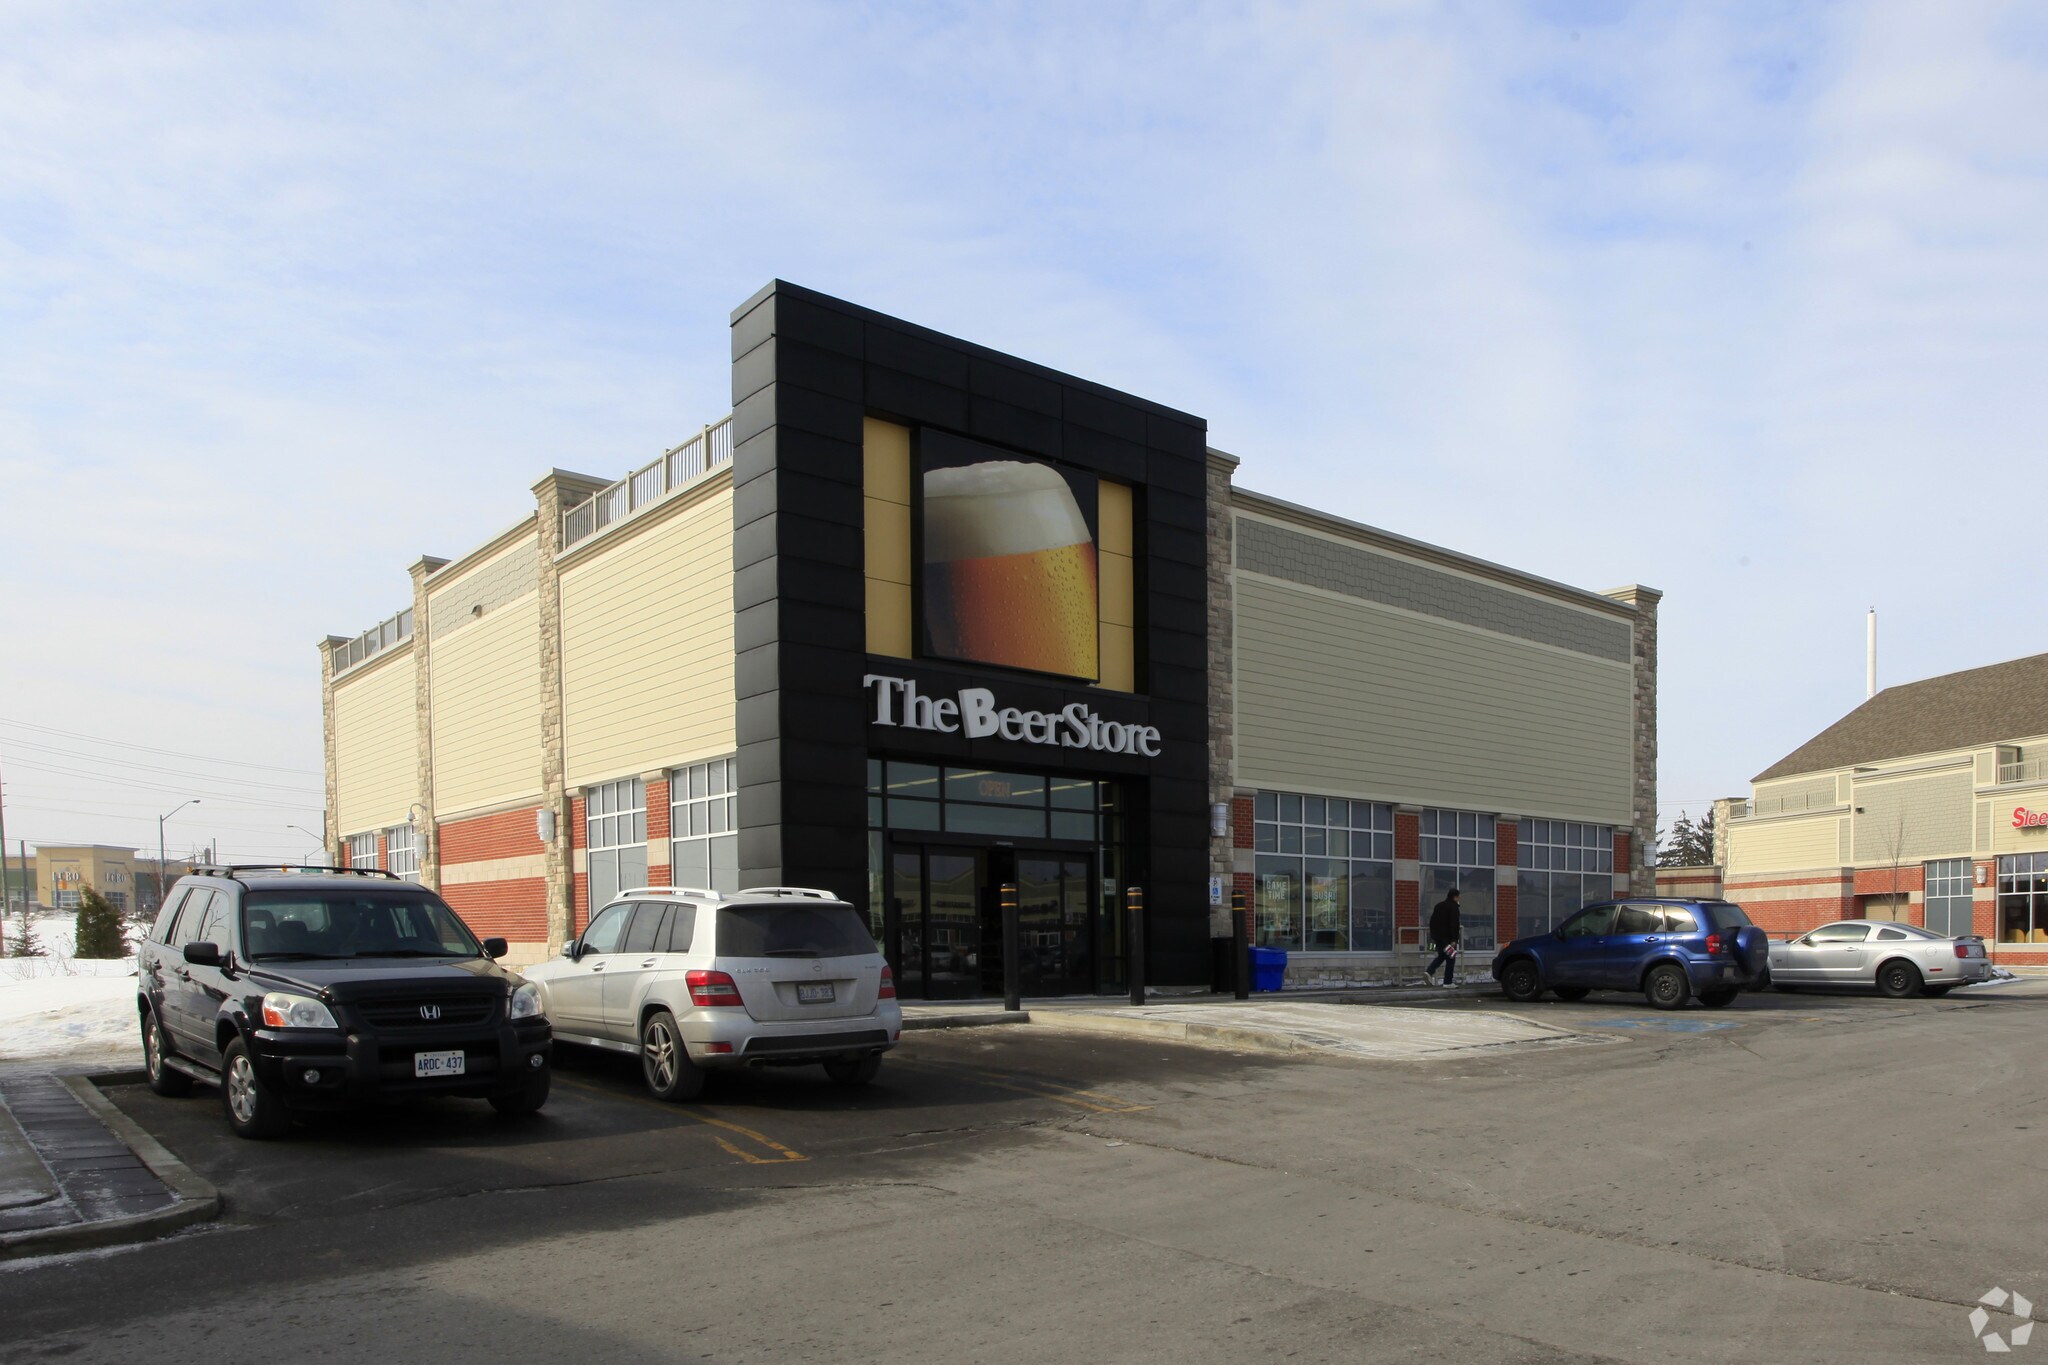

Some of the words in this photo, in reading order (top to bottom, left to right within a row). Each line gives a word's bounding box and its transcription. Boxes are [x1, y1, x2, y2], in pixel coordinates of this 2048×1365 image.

[52, 871, 79, 881] LCBO
[106, 872, 127, 882] LCBO
[1266, 880, 1287, 890] GAME
[1267, 890, 1286, 900] TIME
[1313, 891, 1336, 900] SUSHI
[446, 1056, 462, 1069] 437
